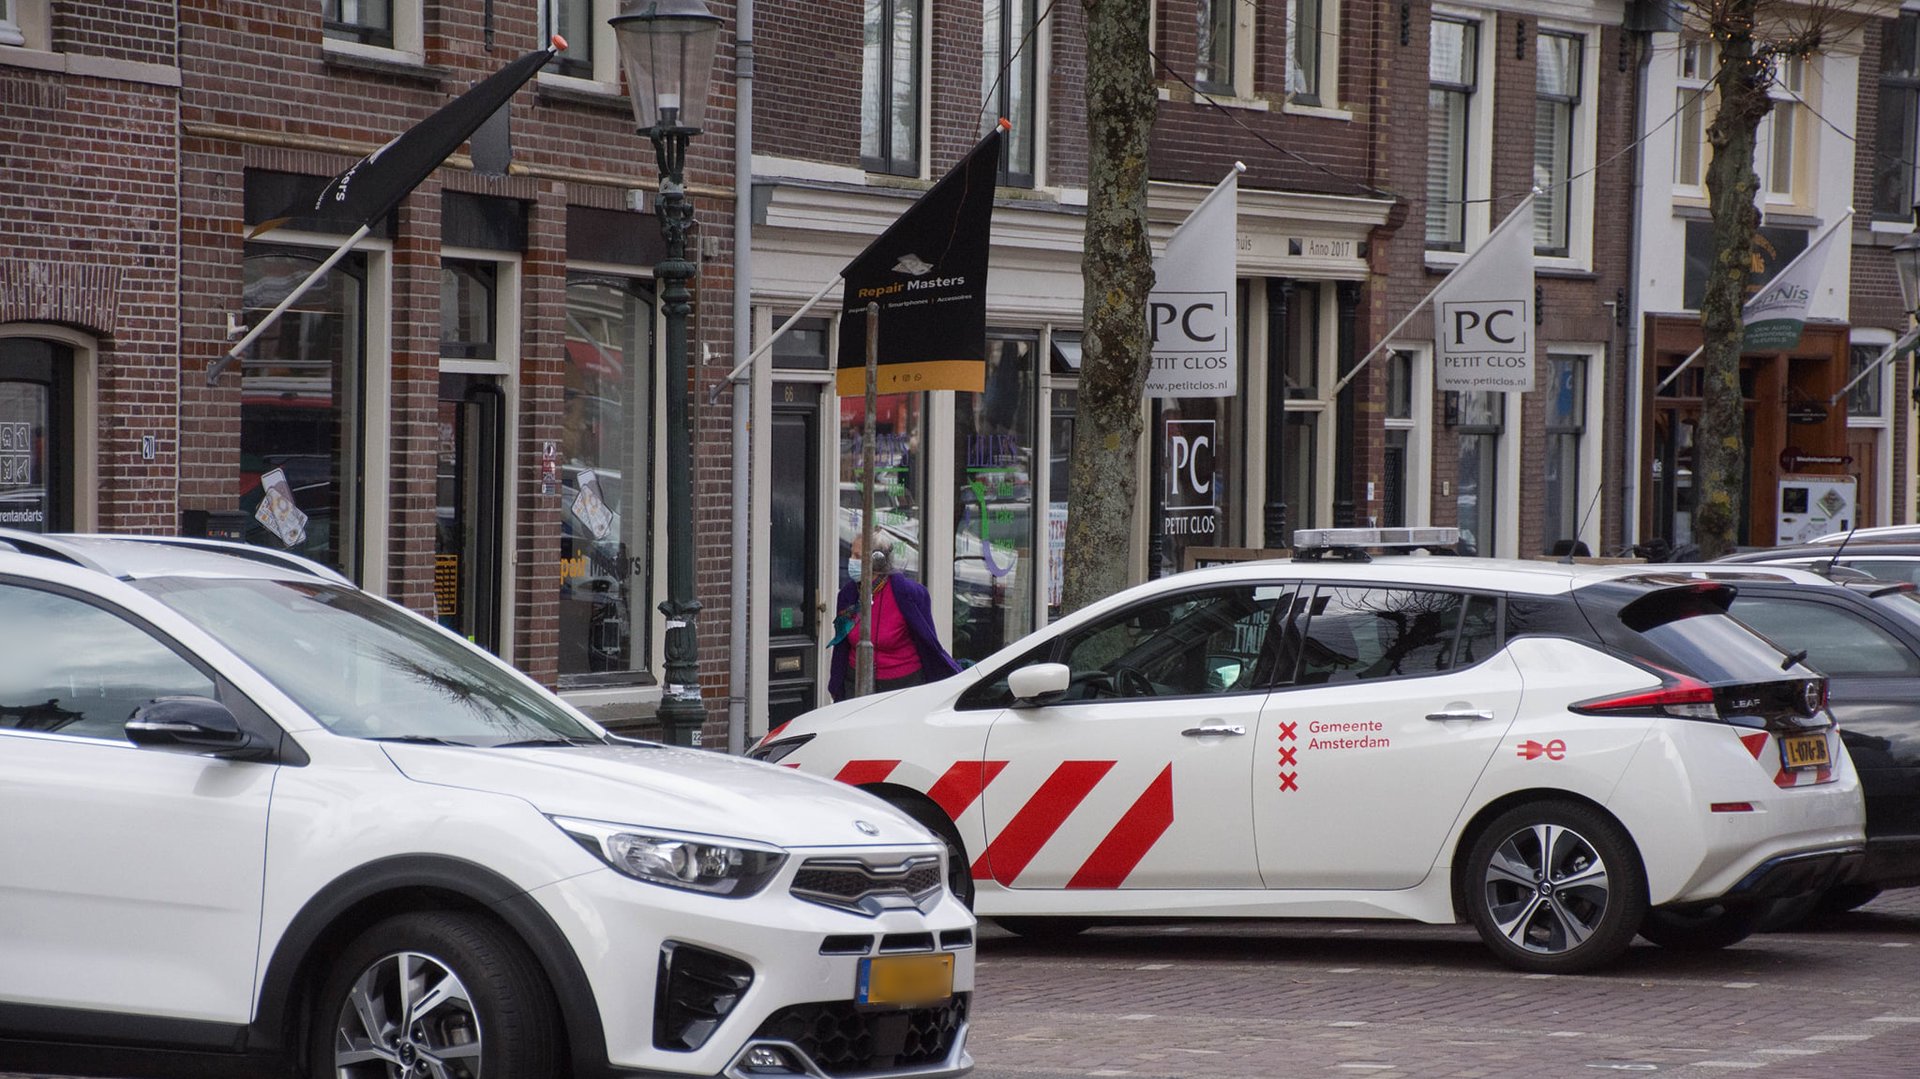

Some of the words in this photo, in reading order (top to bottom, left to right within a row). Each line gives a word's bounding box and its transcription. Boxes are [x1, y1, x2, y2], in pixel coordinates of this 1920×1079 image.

[1308, 240, 1330, 256] Anno
[1330, 241, 1350, 257] 2017
[858, 282, 904, 299] Repair
[907, 276, 966, 292] Masters
[1150, 303, 1217, 343] PC
[1454, 309, 1516, 345] PC
[1183, 357, 1228, 370] CLOS
[1444, 356, 1482, 368] PETIT
[1486, 356, 1527, 368] CLOS
[1445, 377, 1527, 387] www.petitclos.nl
[1171, 435, 1210, 495] PC
[1164, 516, 1188, 535] PETIT
[1190, 515, 1215, 534] CLOS
[1731, 699, 1761, 709] LEAF
[1309, 720, 1383, 734] Gemeente
[1308, 735, 1390, 751] Amsterdam
